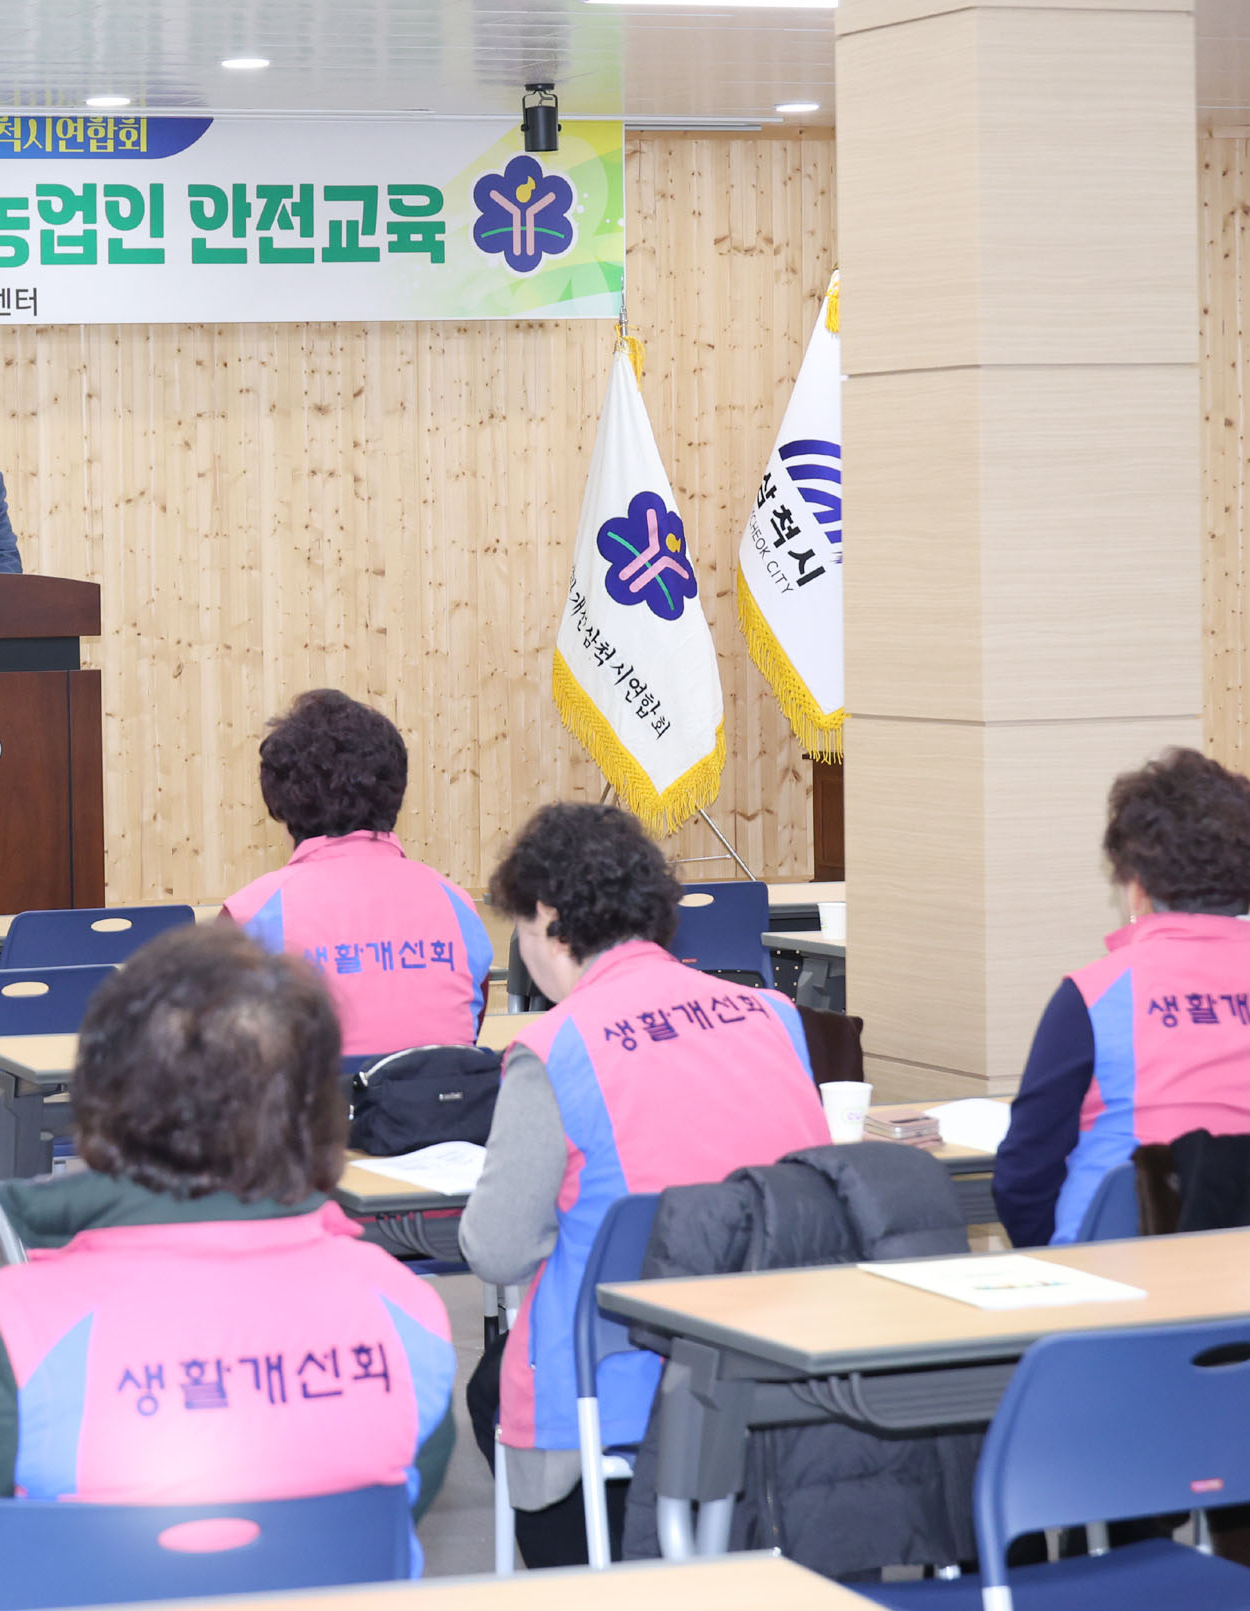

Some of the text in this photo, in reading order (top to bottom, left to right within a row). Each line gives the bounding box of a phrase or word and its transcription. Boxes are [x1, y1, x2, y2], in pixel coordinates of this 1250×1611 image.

[188, 182, 446, 265] 안전교육
[750, 509, 794, 594] CHEOK CITY
[757, 472, 826, 587] 삼척시
[303, 940, 455, 976] 생활개선회
[603, 995, 770, 1051] 생활개선회
[118, 1342, 392, 1416] 생활개선회
